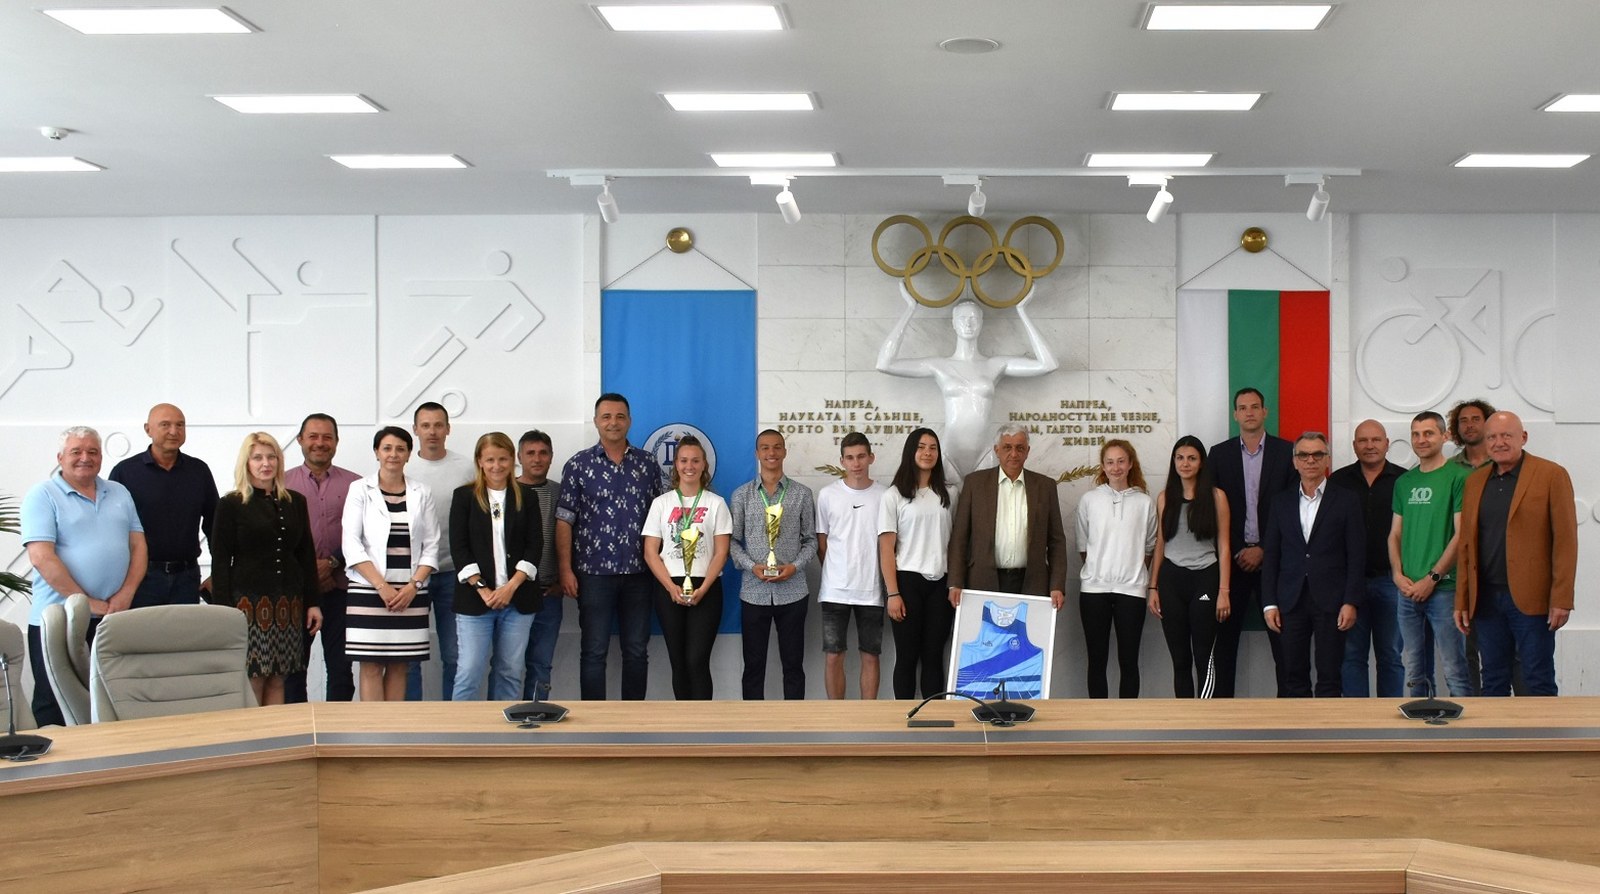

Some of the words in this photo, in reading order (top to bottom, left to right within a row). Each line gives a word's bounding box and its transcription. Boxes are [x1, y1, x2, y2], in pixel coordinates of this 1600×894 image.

[825, 399, 879, 411] НАПРЕД,
[1060, 399, 1112, 411] НАПРЕД,
[779, 412, 842, 421] НАУКАТА
[849, 412, 857, 421] Е
[864, 412, 924, 423] СЛЪНЦЕ,
[1009, 411, 1097, 422] НАРОДНОСТТА
[1100, 412, 1117, 422] НЕ
[1121, 412, 1161, 423] ЧЕЗНЕ,
[777, 425, 824, 434] КОЕТО
[832, 425, 857, 434] ВЪВ
[1046, 424, 1082, 434] ГДЕТО
[1088, 424, 1153, 434] ЗНАНИЕТО
[1408, 487, 1433, 502] 100
[667, 506, 709, 524] NE
